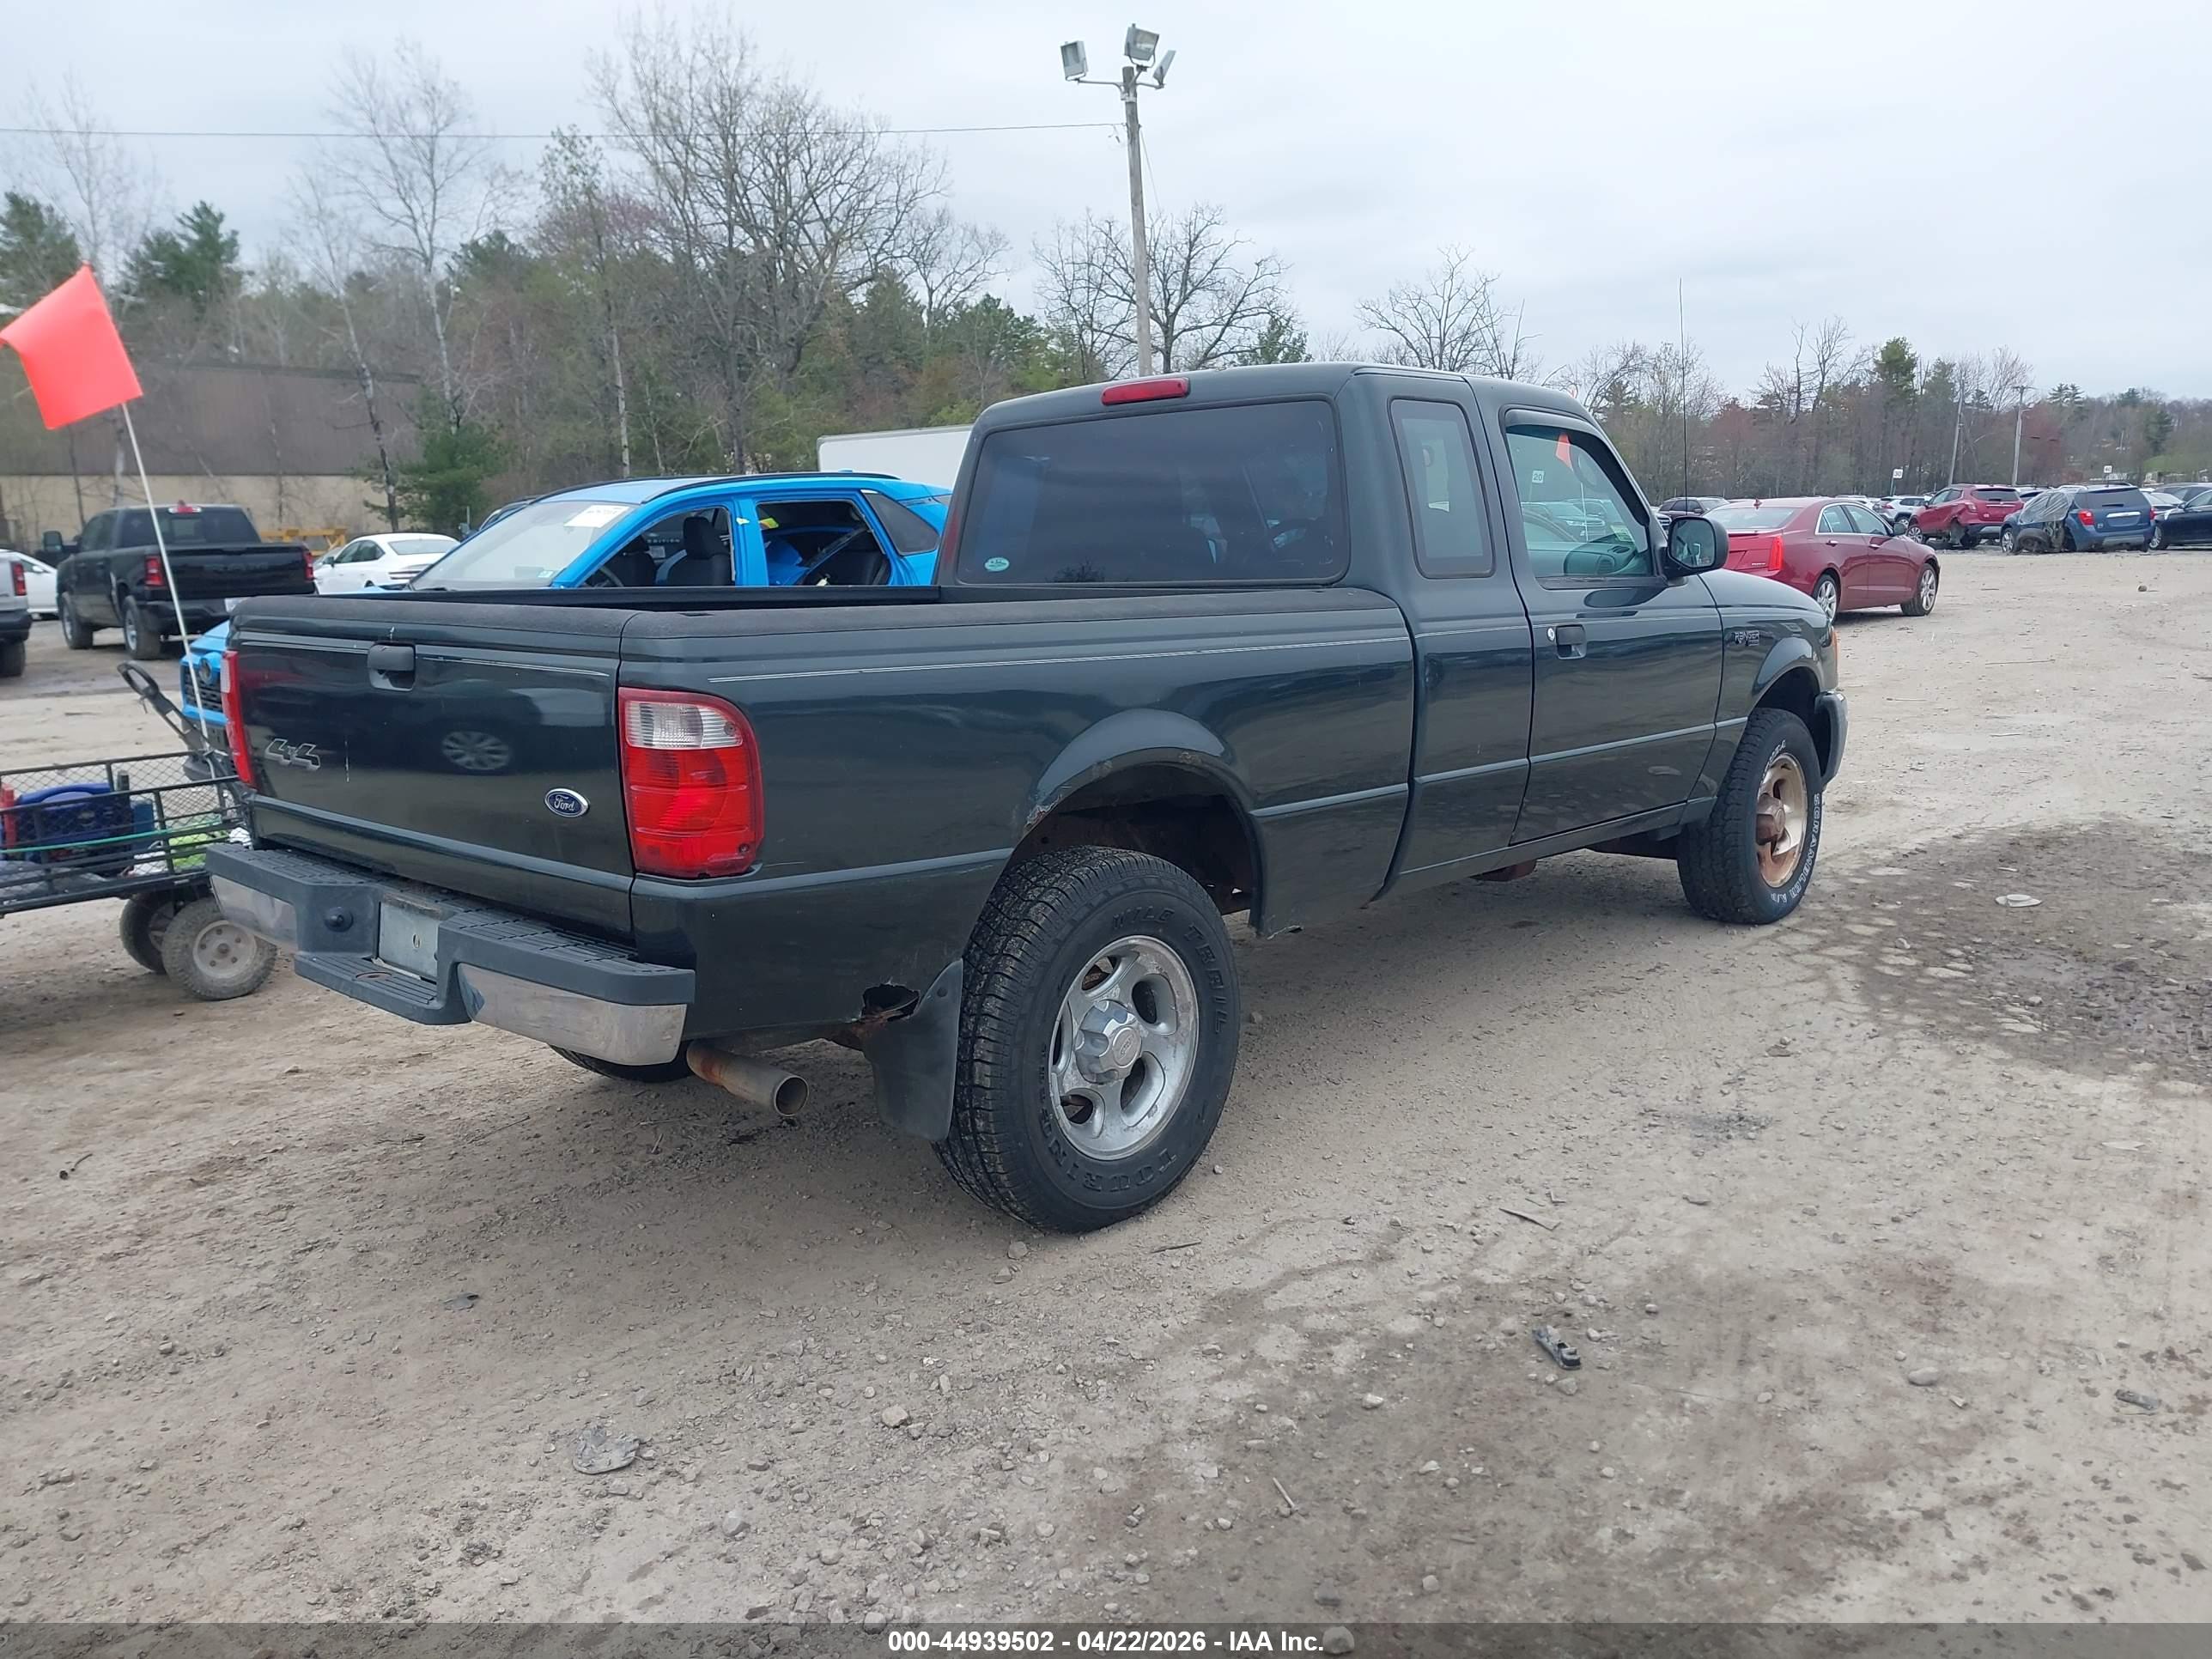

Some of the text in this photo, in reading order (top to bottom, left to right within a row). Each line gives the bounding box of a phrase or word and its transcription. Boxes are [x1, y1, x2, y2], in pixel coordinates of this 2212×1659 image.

[265, 738, 321, 770] 4x4
[554, 794, 575, 811] Ford
[1183, 921, 1229, 1035] TRAIL
